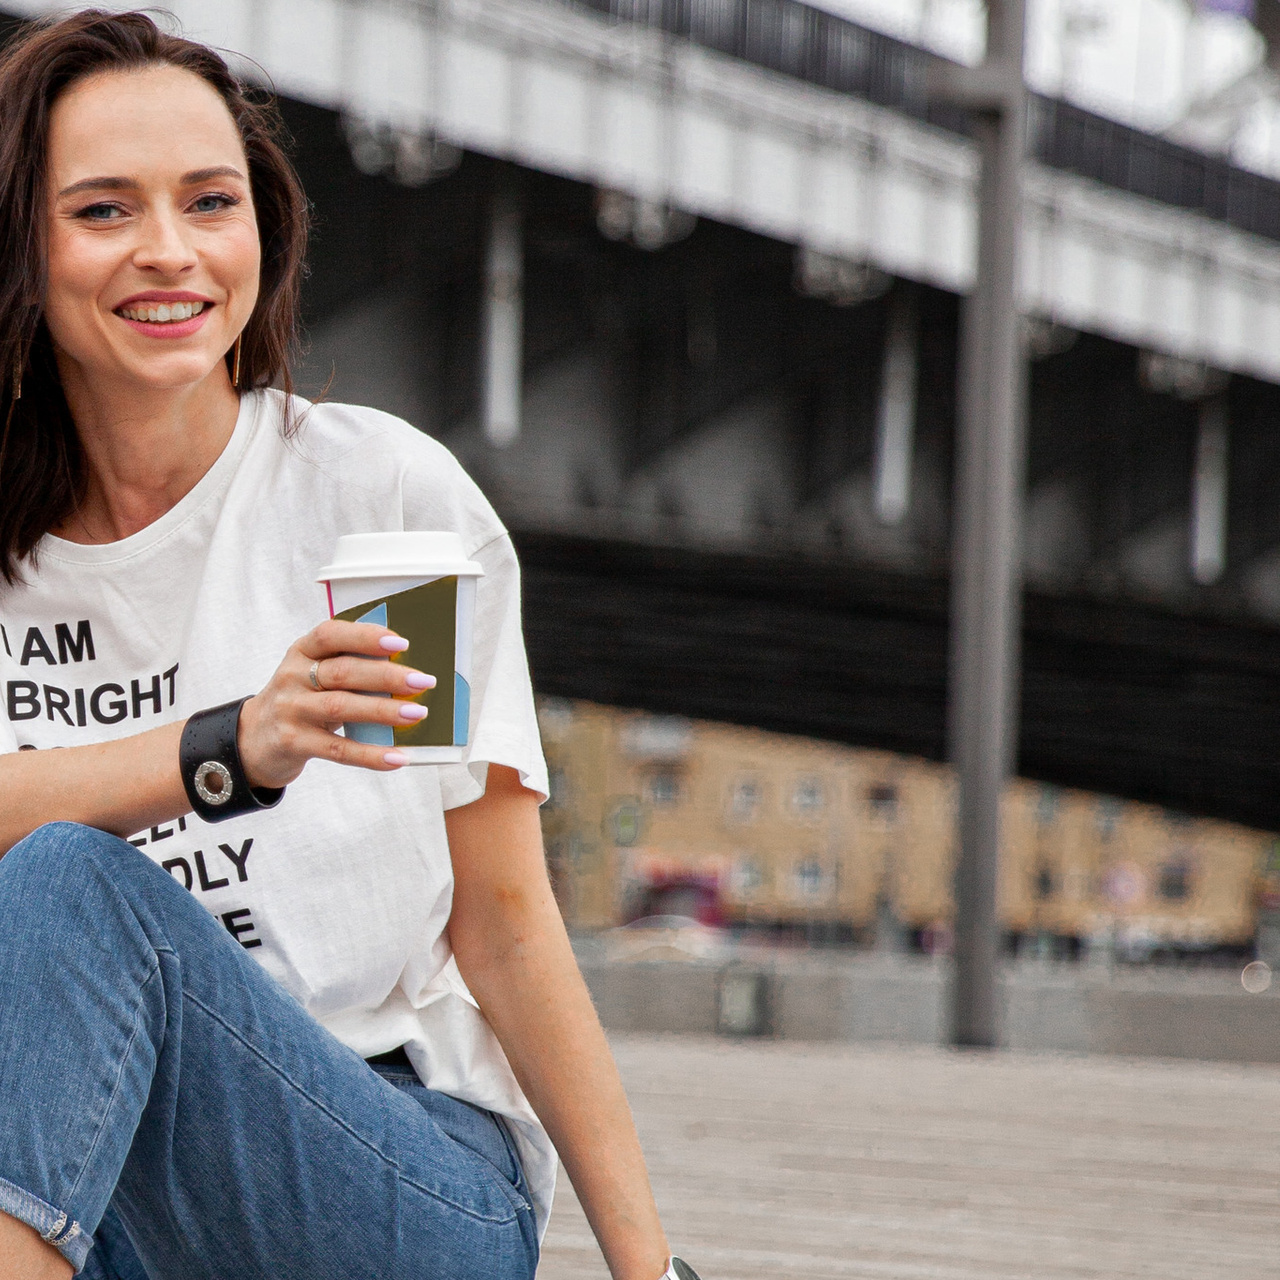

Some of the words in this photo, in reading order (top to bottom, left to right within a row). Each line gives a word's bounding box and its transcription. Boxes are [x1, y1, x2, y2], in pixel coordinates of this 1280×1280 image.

[20, 619, 96, 666] AM
[6, 662, 180, 728] BRIGHT
[161, 837, 255, 892] DLY
